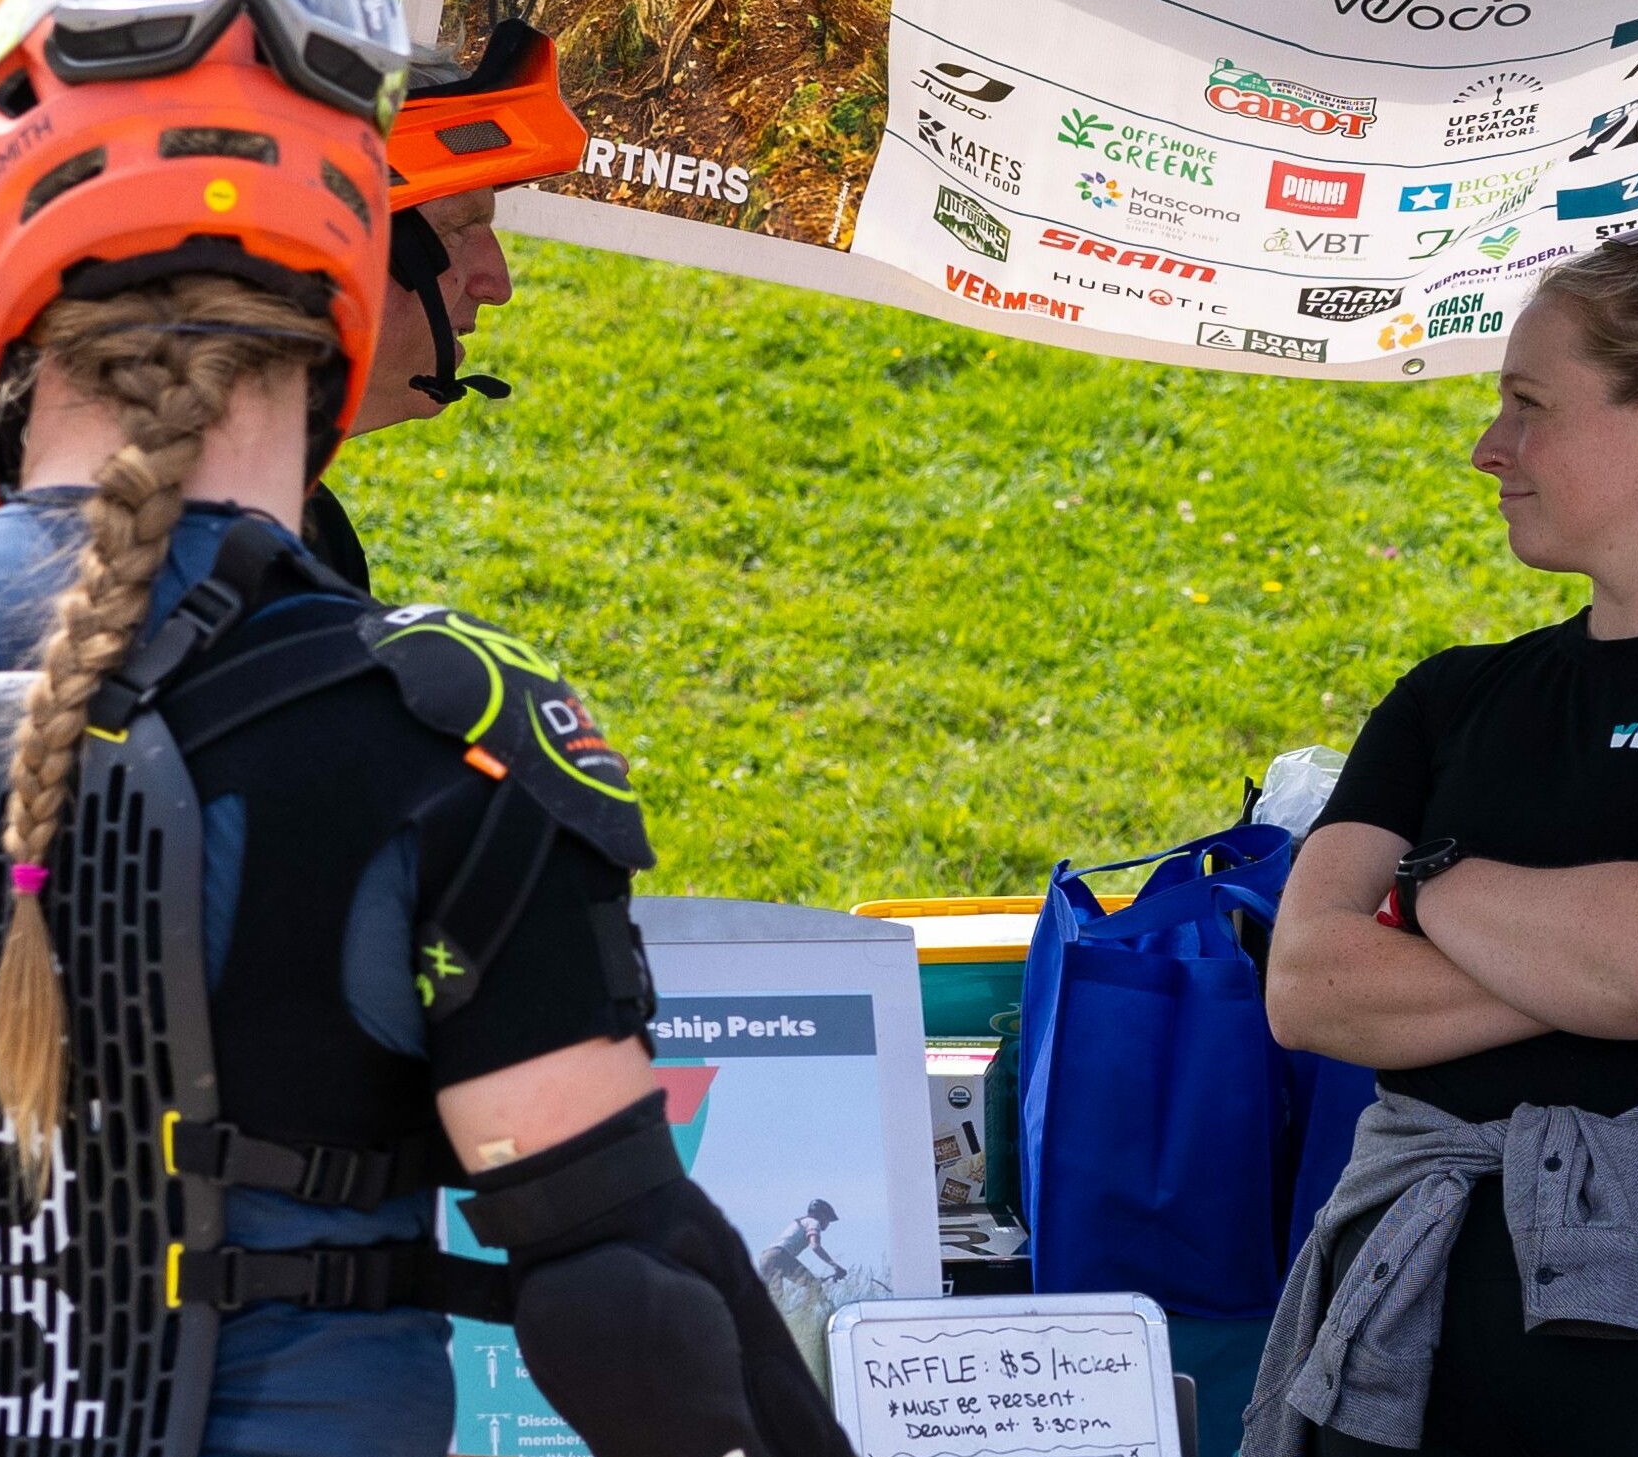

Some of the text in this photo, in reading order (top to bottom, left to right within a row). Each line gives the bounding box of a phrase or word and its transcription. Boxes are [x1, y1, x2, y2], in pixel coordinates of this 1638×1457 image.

[1445, 114, 1536, 137] ELEVATOR
[1448, 103, 1540, 127] UPSTATE
[951, 132, 1023, 182] KATE'S
[1121, 125, 1218, 164] OFFSHORE
[578, 137, 750, 205] RTNERS
[949, 153, 1021, 196] REAL FOOD
[1104, 141, 1214, 187] GREENS
[1457, 159, 1556, 193] BICYCLE
[1128, 201, 1185, 227] Bank
[1130, 186, 1241, 224] Mascoma
[941, 192, 1005, 249] OUTDOORS
[1038, 227, 1215, 285] SRAM
[1294, 231, 1368, 255] VBT
[1424, 245, 1579, 294] VERMONT FEDERAL
[1451, 276, 1497, 289] CREDIT
[947, 264, 1084, 322] VERMONT
[1306, 287, 1400, 306] DARN
[1427, 292, 1484, 317] TRASH
[1304, 299, 1398, 317] TOUGH
[1427, 310, 1503, 339] GEAR CO
[1250, 342, 1320, 362] PASS
[1252, 332, 1322, 354] LOAM
[727, 1015, 816, 1038] Perks
[1000, 1350, 1041, 1379] $5
[1031, 1416, 1111, 1434] 3:30pm
